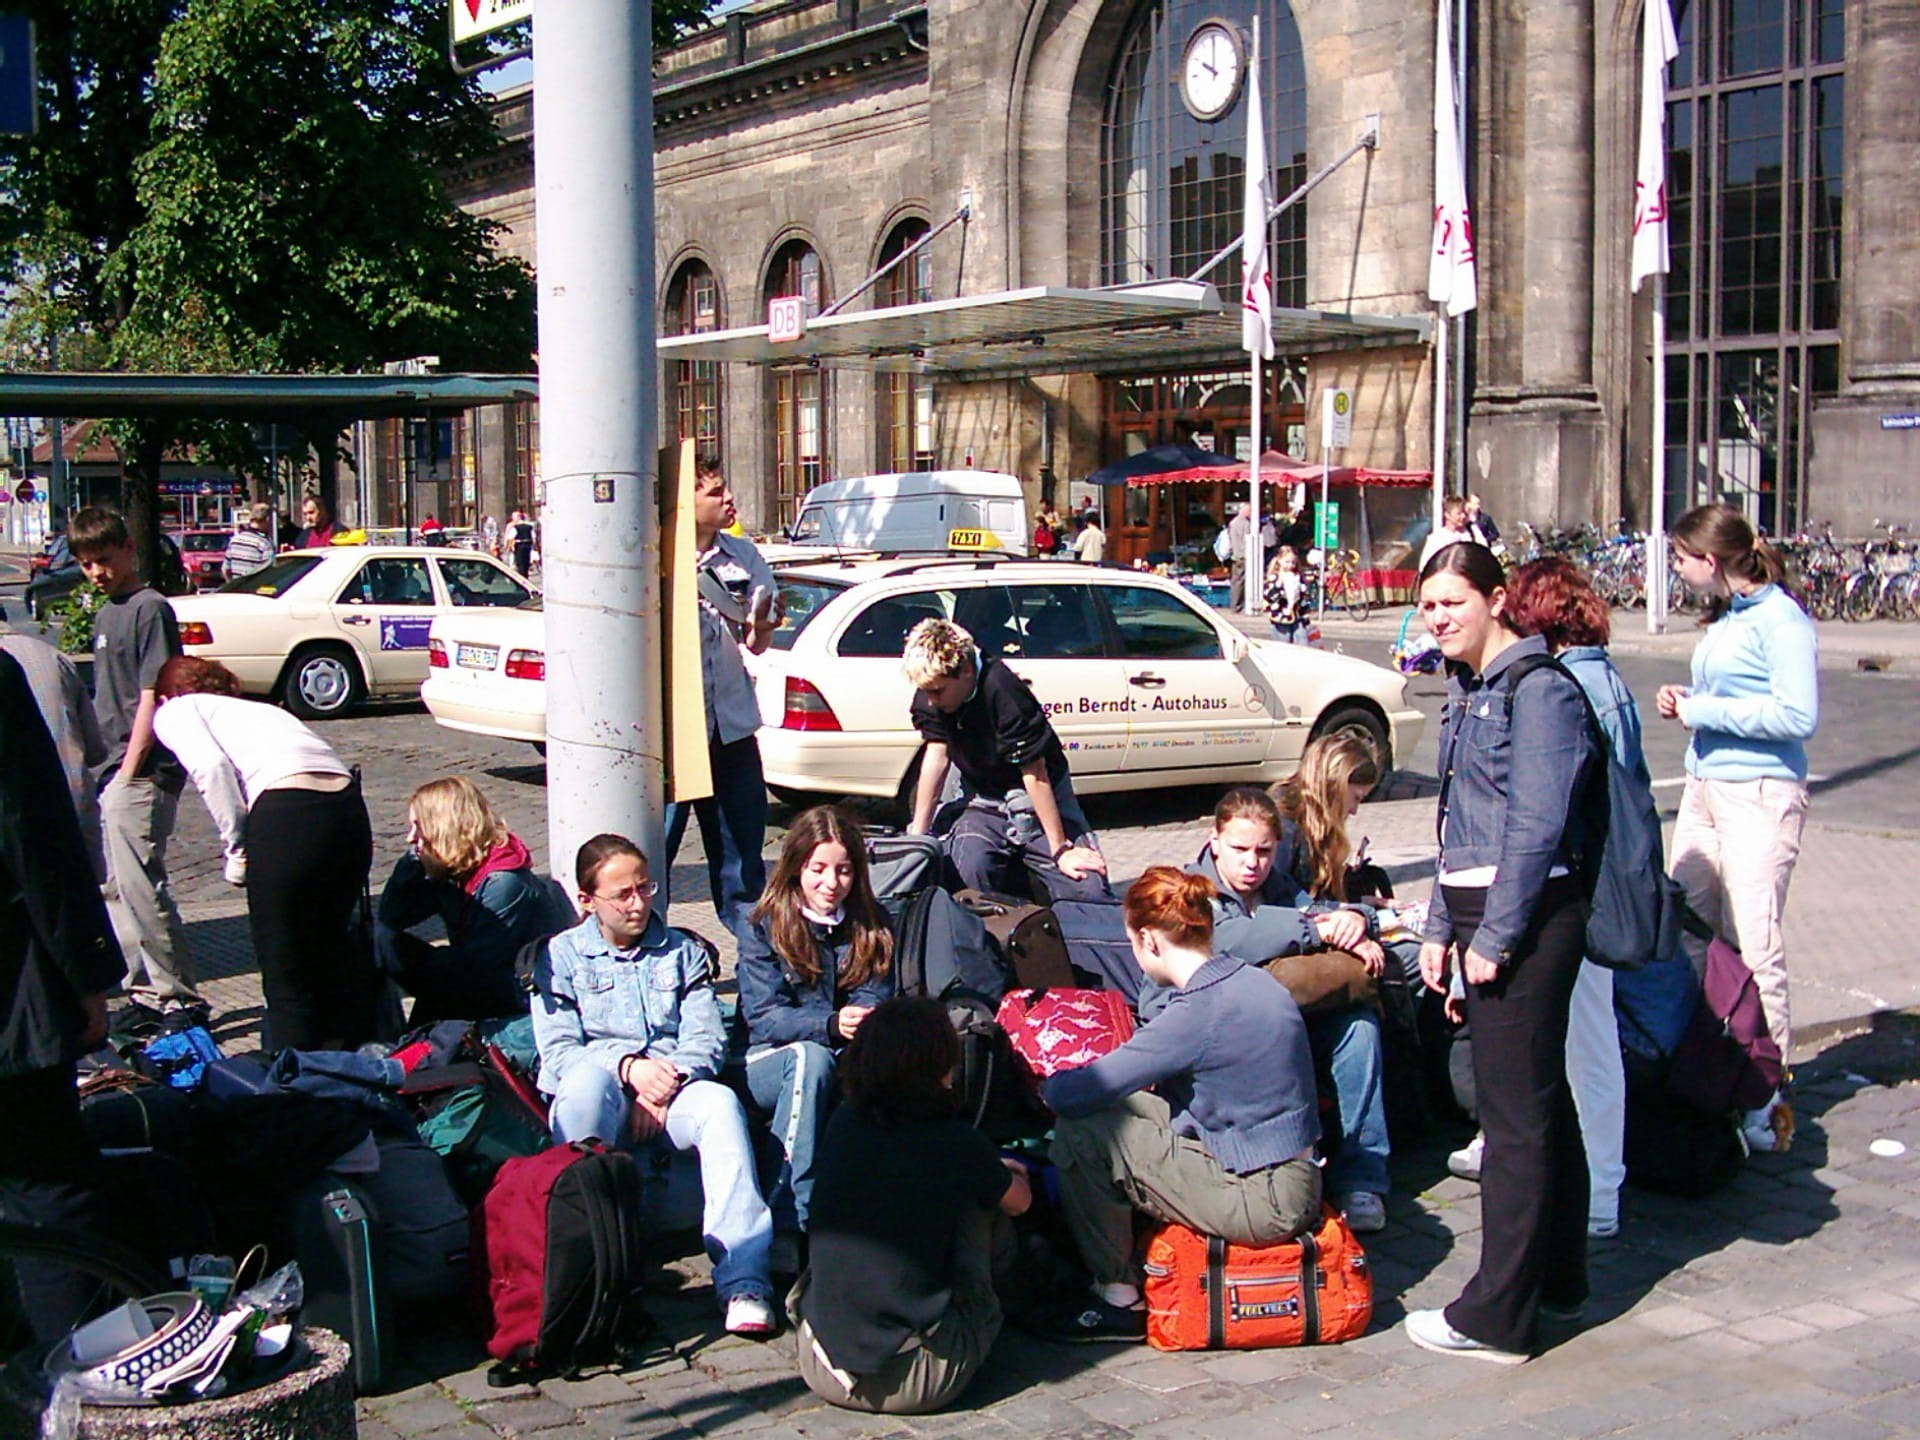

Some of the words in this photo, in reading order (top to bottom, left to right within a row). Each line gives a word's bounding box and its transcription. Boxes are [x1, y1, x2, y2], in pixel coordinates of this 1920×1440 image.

[774, 304, 796, 335] DB
[953, 531, 981, 545] TAXI
[1041, 701, 1073, 718] gen
[1079, 697, 1137, 713] Berndt
[1152, 693, 1228, 711] Autohaus
